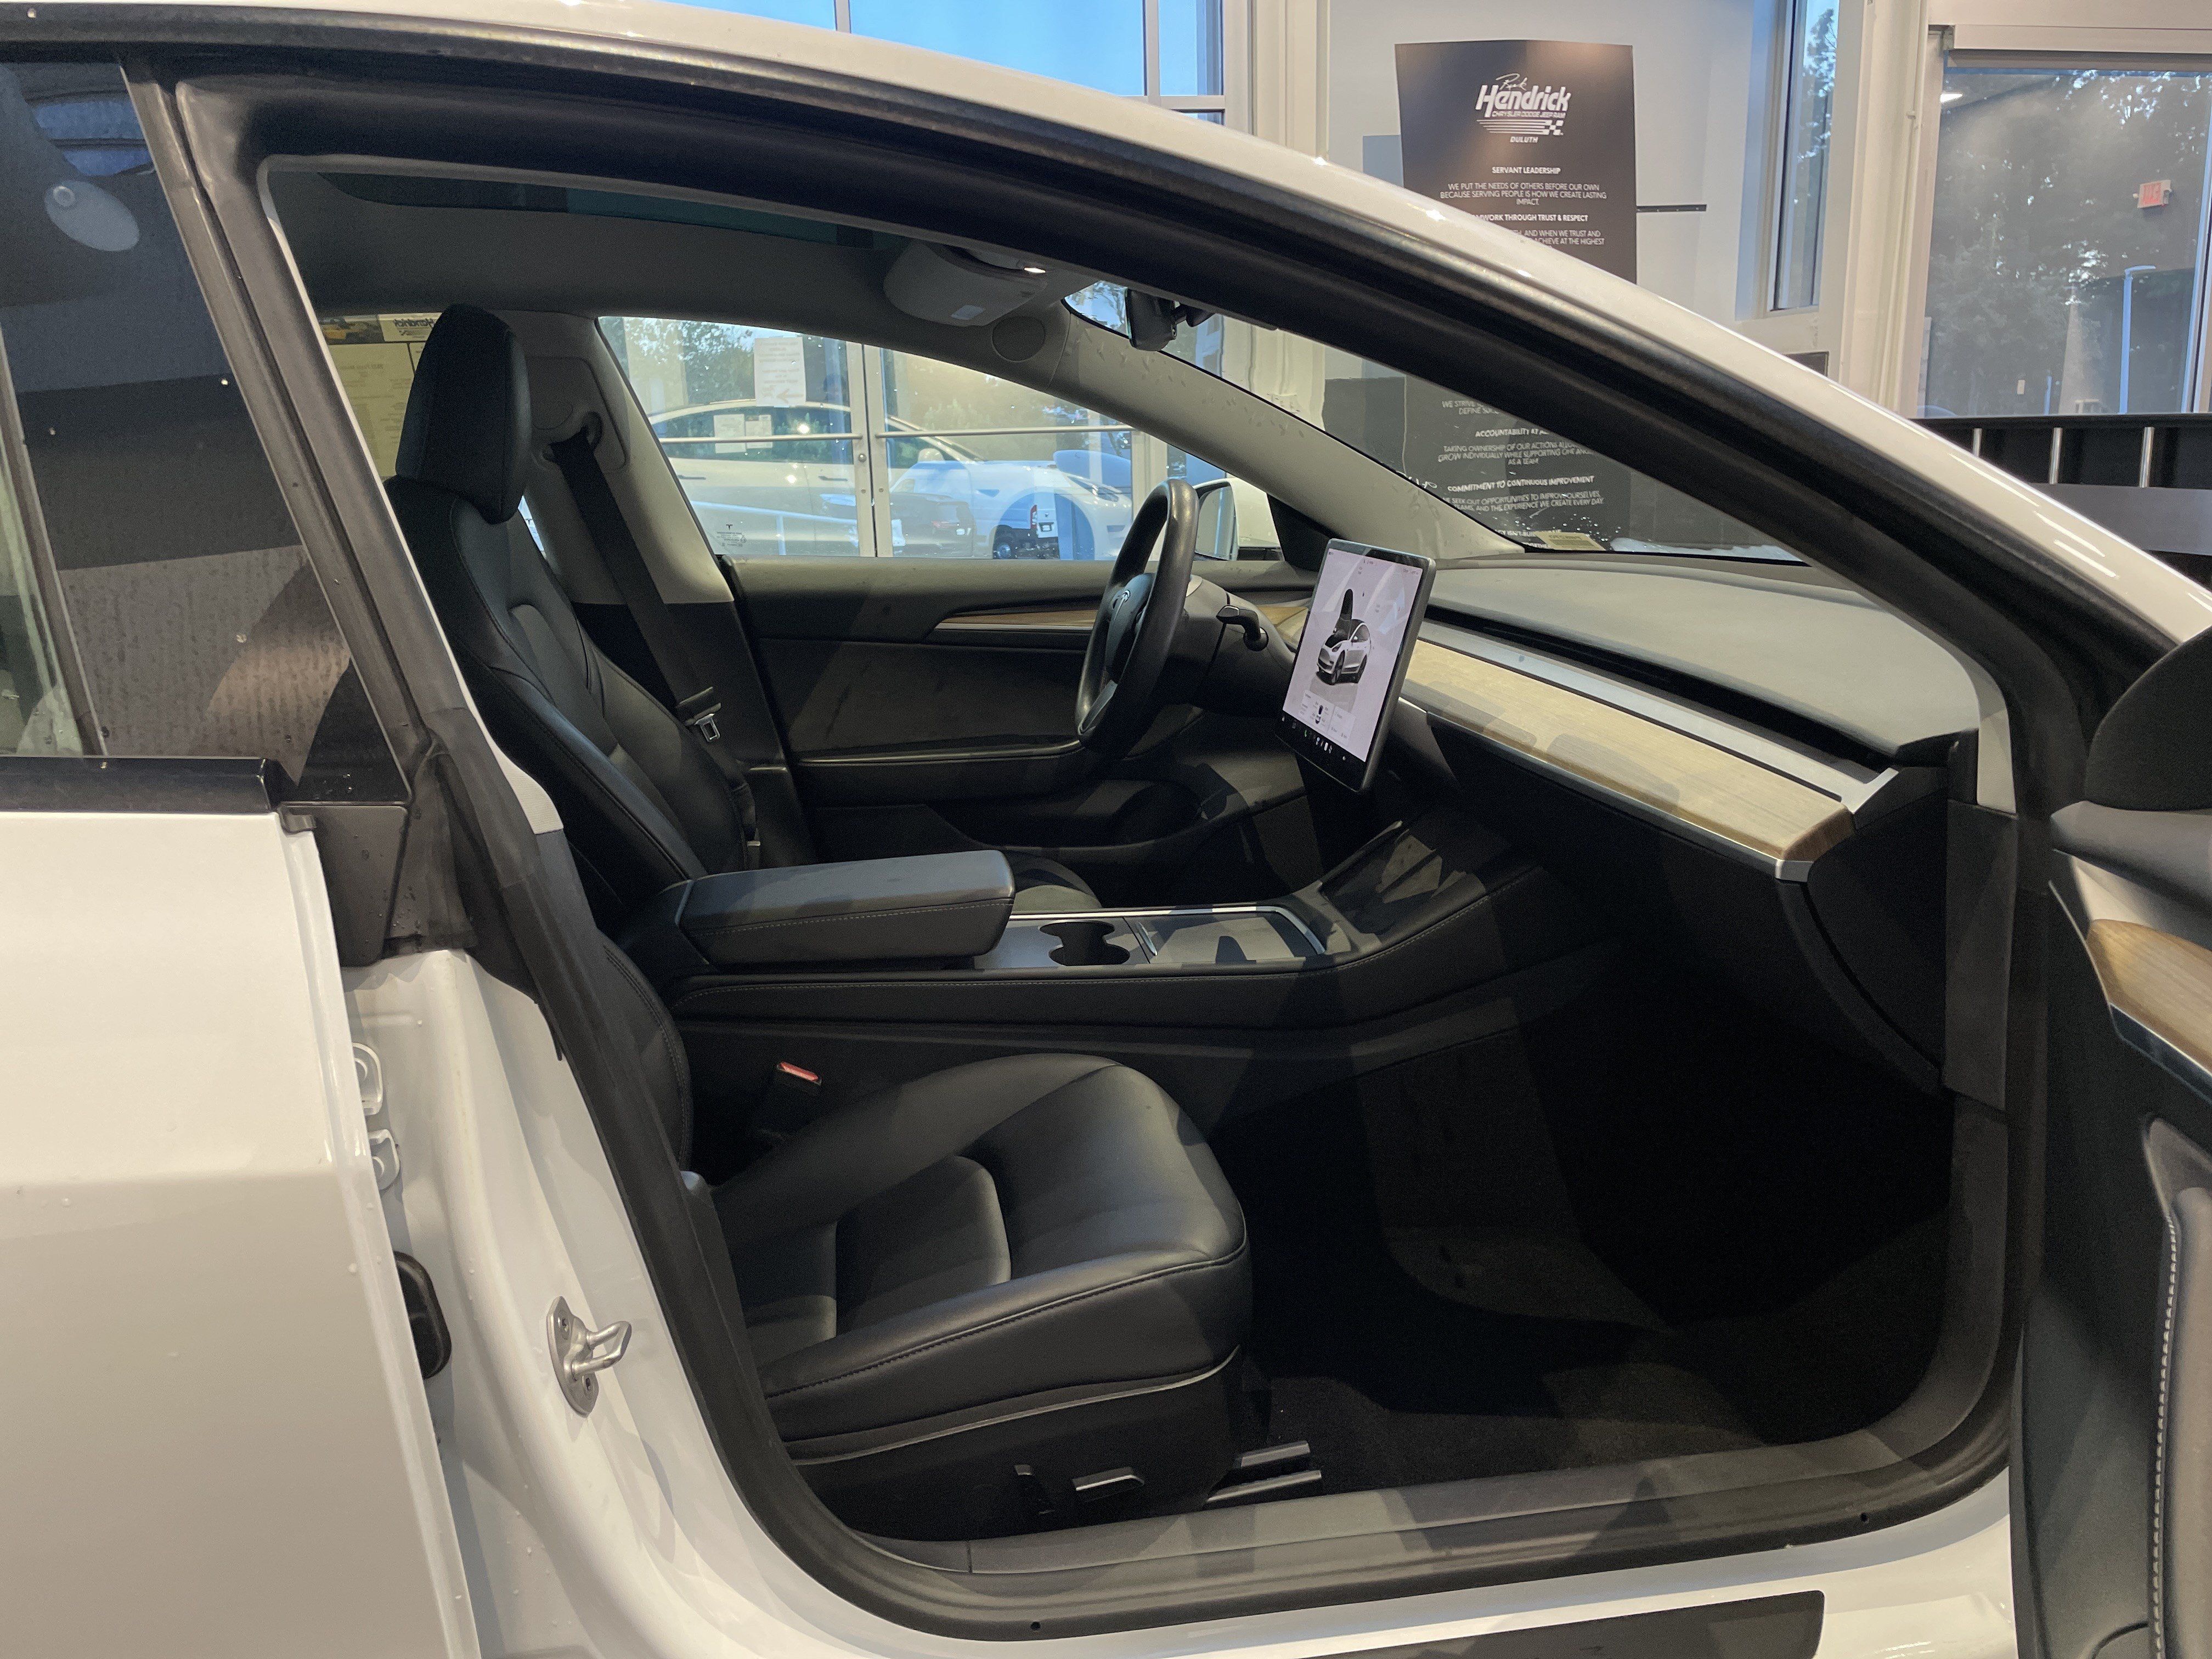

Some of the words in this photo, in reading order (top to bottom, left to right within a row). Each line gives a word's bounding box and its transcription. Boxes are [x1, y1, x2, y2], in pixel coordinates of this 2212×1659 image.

[1475, 84, 1572, 118] Hendrick
[1458, 407, 1481, 415] DEFINE
[1475, 428, 1530, 437] ACCOUNTABILITY
[1468, 444, 1506, 452] OWNERSHIP
[1506, 442, 1515, 451] OF
[1516, 442, 1531, 450] OUR
[1531, 441, 1558, 449] ACTIONS
[1438, 453, 1462, 462] GROW
[1462, 452, 1503, 460] INDIVIDUALLY
[1523, 448, 1561, 458] SUPPORTING
[1447, 482, 1495, 492] COMMITMENT
[1497, 480, 1506, 489] TO
[1506, 479, 1548, 488] CONTINUOUS
[1548, 475, 1595, 486] IMPROVEMENT
[1481, 494, 1530, 505] OPPORTUNITIES
